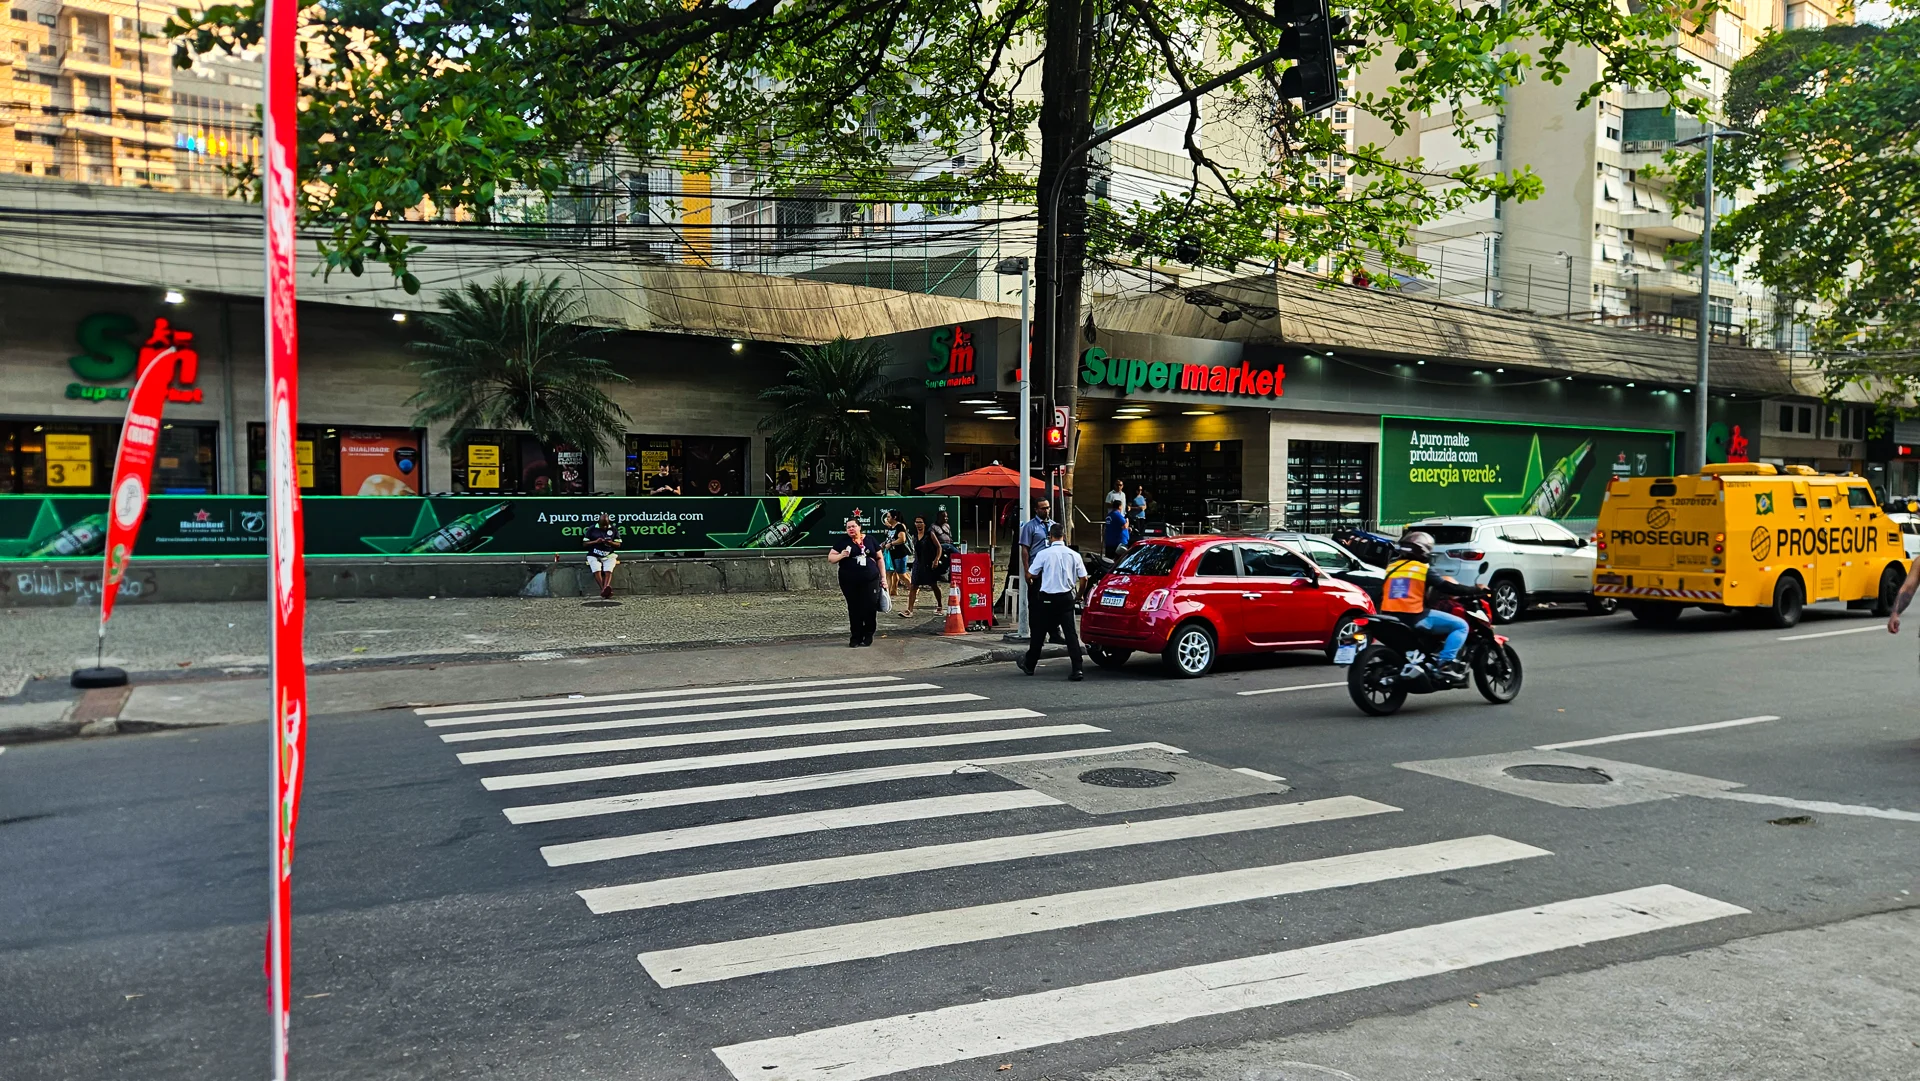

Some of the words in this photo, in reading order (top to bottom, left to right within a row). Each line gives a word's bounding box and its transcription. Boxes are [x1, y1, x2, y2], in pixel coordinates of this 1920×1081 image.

[926, 326, 973, 374] Sm
[1081, 347, 1286, 396] Supermarket
[925, 374, 975, 388] Supermarket
[1410, 430, 1418, 445] A
[1419, 434, 1442, 449] puro
[1443, 432, 1470, 447] malte
[1409, 446, 1457, 464] produzida
[1458, 451, 1478, 463] com
[50, 464, 65, 484] 3
[470, 469, 482, 486] 7
[1409, 463, 1460, 487] energia
[180, 520, 224, 529] Heineken
[537, 512, 547, 523] A
[549, 513, 579, 524] puro
[581, 511, 616, 522] mae
[618, 511, 677, 524] produzida
[679, 512, 704, 521] com
[1611, 530, 1709, 546] PROSEGUR
[1777, 526, 1877, 557] PROSEGUR
